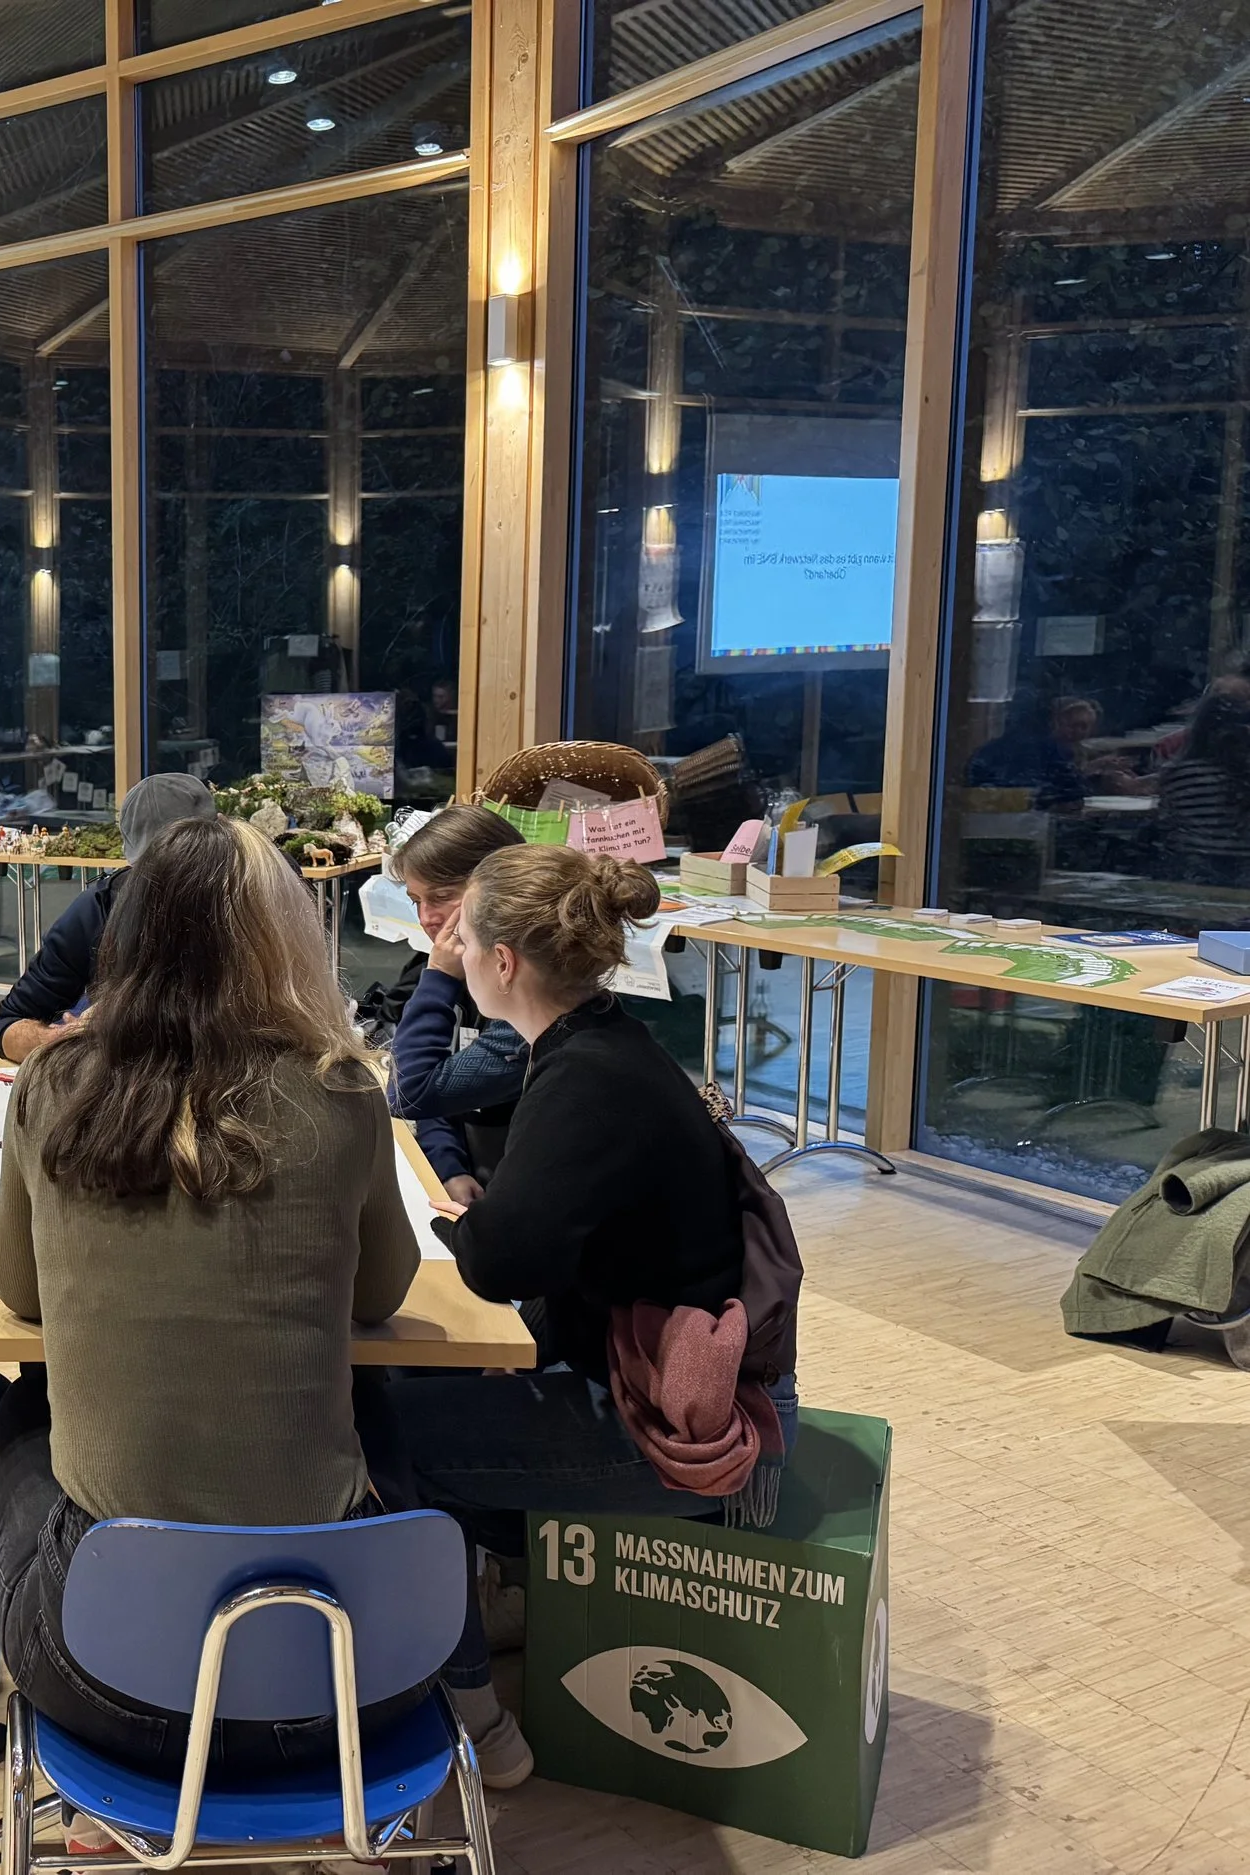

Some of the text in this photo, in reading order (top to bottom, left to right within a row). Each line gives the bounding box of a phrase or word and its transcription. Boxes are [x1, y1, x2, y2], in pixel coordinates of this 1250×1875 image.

[625, 819, 636, 827] ein
[582, 827, 645, 844] fannkuchen mit
[634, 836, 651, 845] tun?
[538, 1519, 846, 1606] 13 MASSNAHMEN ZUM
[614, 1565, 782, 1630] KLIMASCHUTZ
